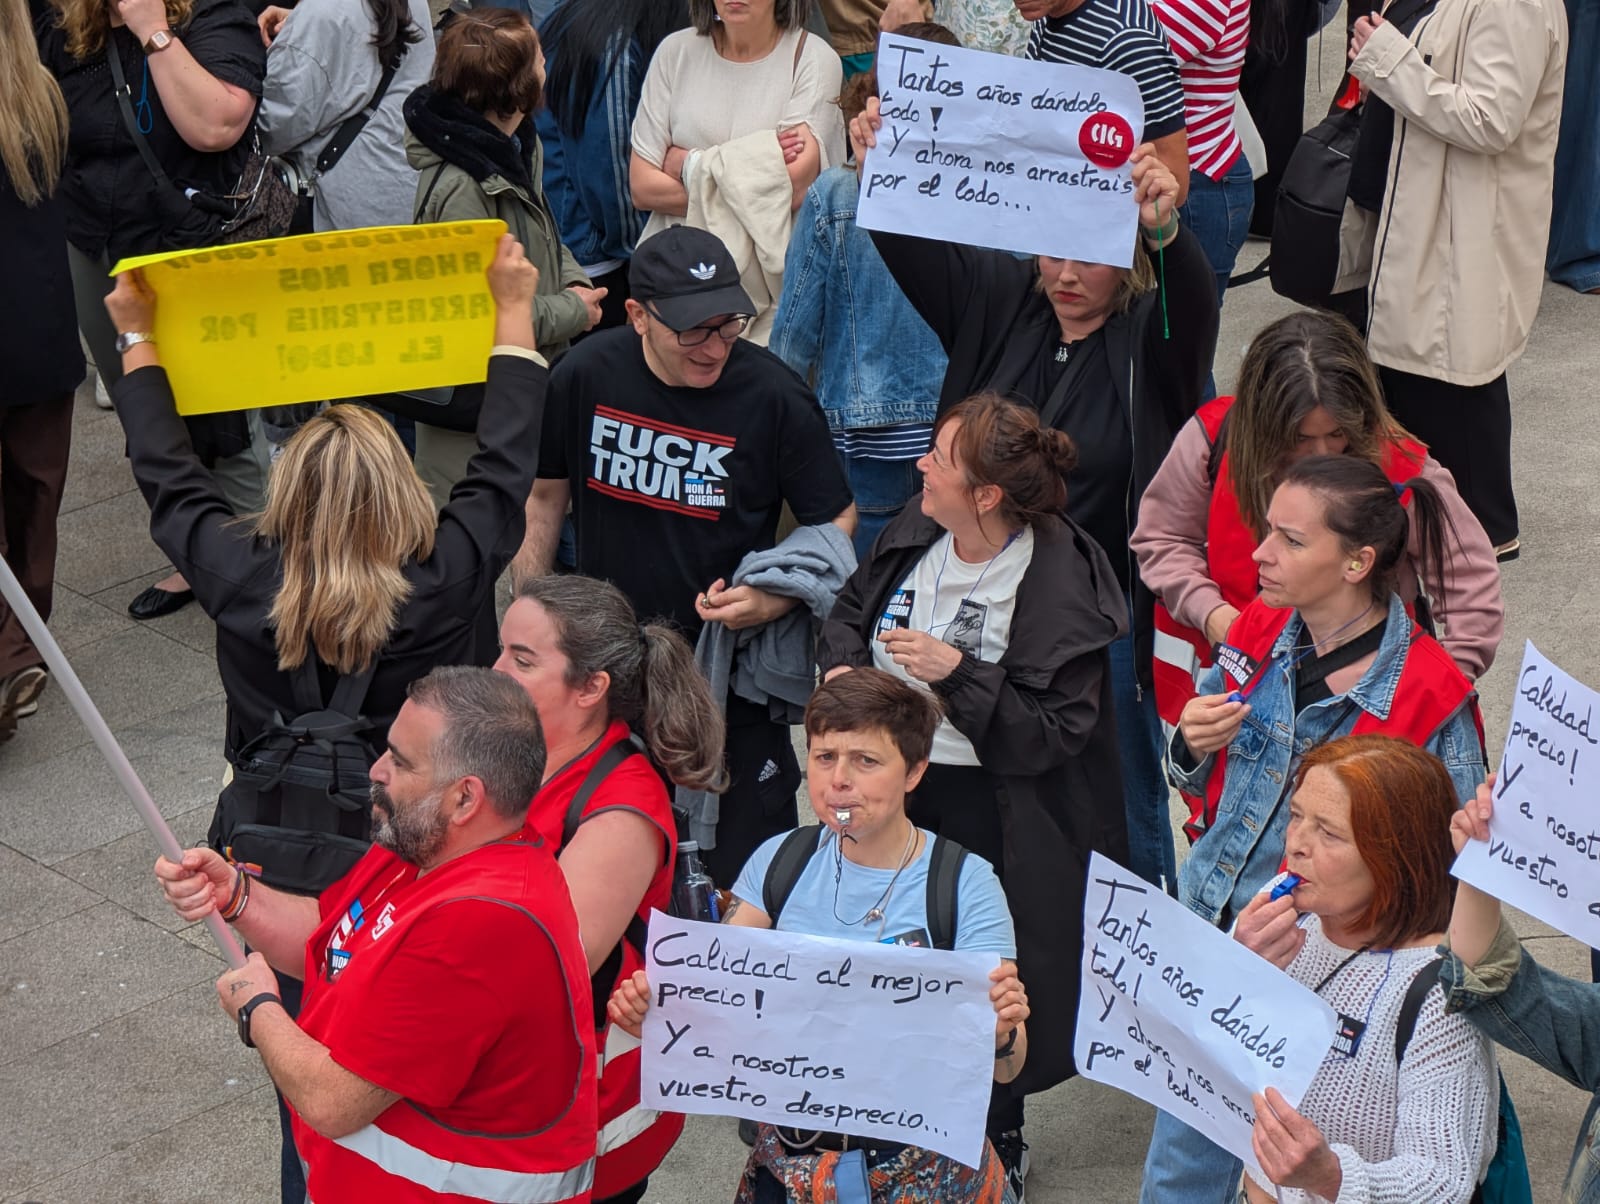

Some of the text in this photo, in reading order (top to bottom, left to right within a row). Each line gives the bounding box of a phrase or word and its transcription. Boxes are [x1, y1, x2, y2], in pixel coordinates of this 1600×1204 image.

[888, 44, 1107, 113] Tantos años dándolo
[888, 125, 1133, 194] Y ahora nos arrastrais
[1091, 123, 1123, 148] CIG
[866, 172, 907, 198] por
[918, 173, 941, 197] el
[591, 415, 734, 478] FUCK
[685, 484, 704, 495] NON
[688, 495, 726, 507] GUERRA
[1520, 665, 1598, 744] Calidad
[1497, 753, 1524, 800] Y
[1508, 720, 1579, 786] precio!
[1519, 801, 1600, 861] a nosot
[1489, 836, 1568, 899] vuestro
[652, 931, 964, 1004] Calidad al mejor
[1095, 878, 1287, 1069] Tantos años dándolo
[657, 981, 765, 1019] precio!
[660, 1020, 846, 1080] Y a nosotros
[1086, 1041, 1125, 1071] por
[1134, 1054, 1152, 1077] el
[1127, 1016, 1176, 1068] ahora
[1187, 1065, 1215, 1095] nos
[659, 1076, 767, 1107] vuestro
